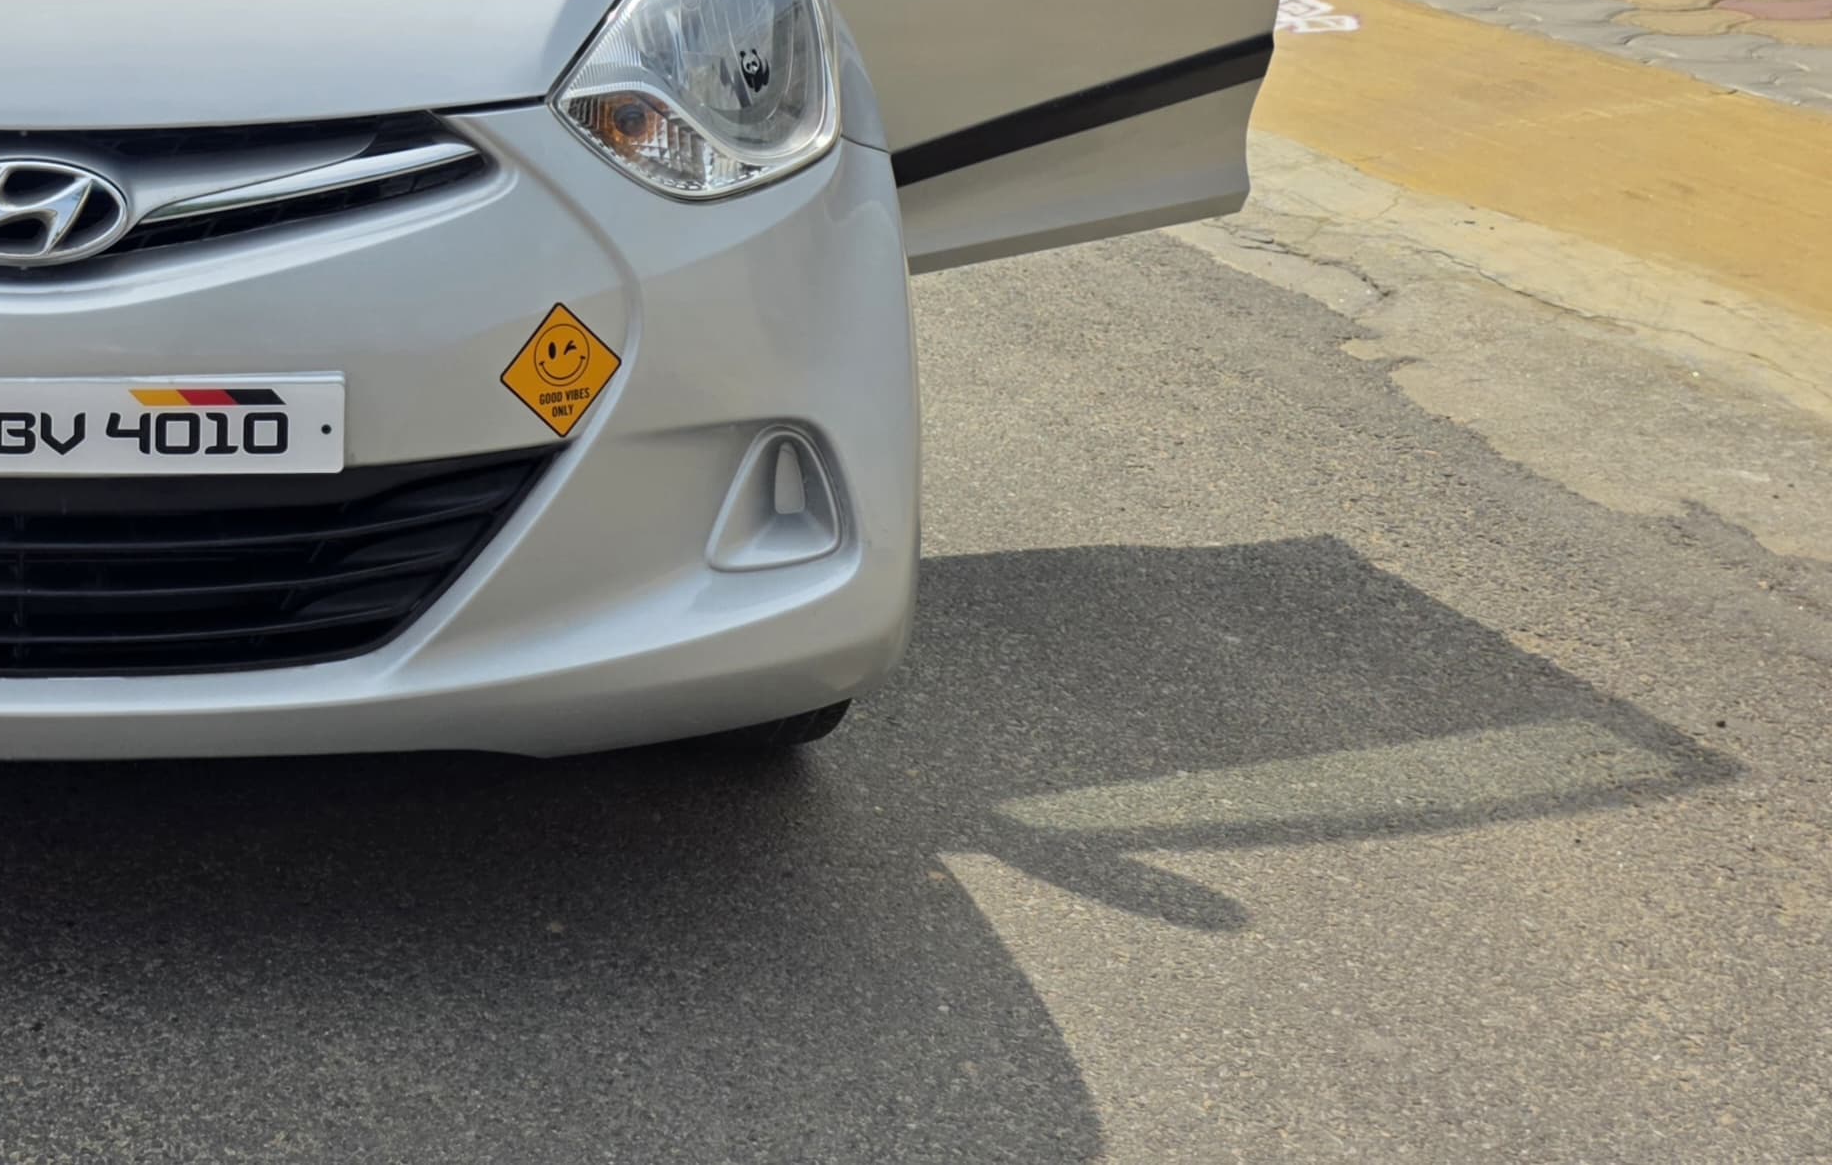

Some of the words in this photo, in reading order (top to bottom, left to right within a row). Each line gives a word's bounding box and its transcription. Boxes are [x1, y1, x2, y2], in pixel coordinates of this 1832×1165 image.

[539, 391, 563, 405] GOOD
[565, 387, 590, 401] VIBES
[552, 404, 574, 417] ONLY
[105, 411, 289, 455] 4010
